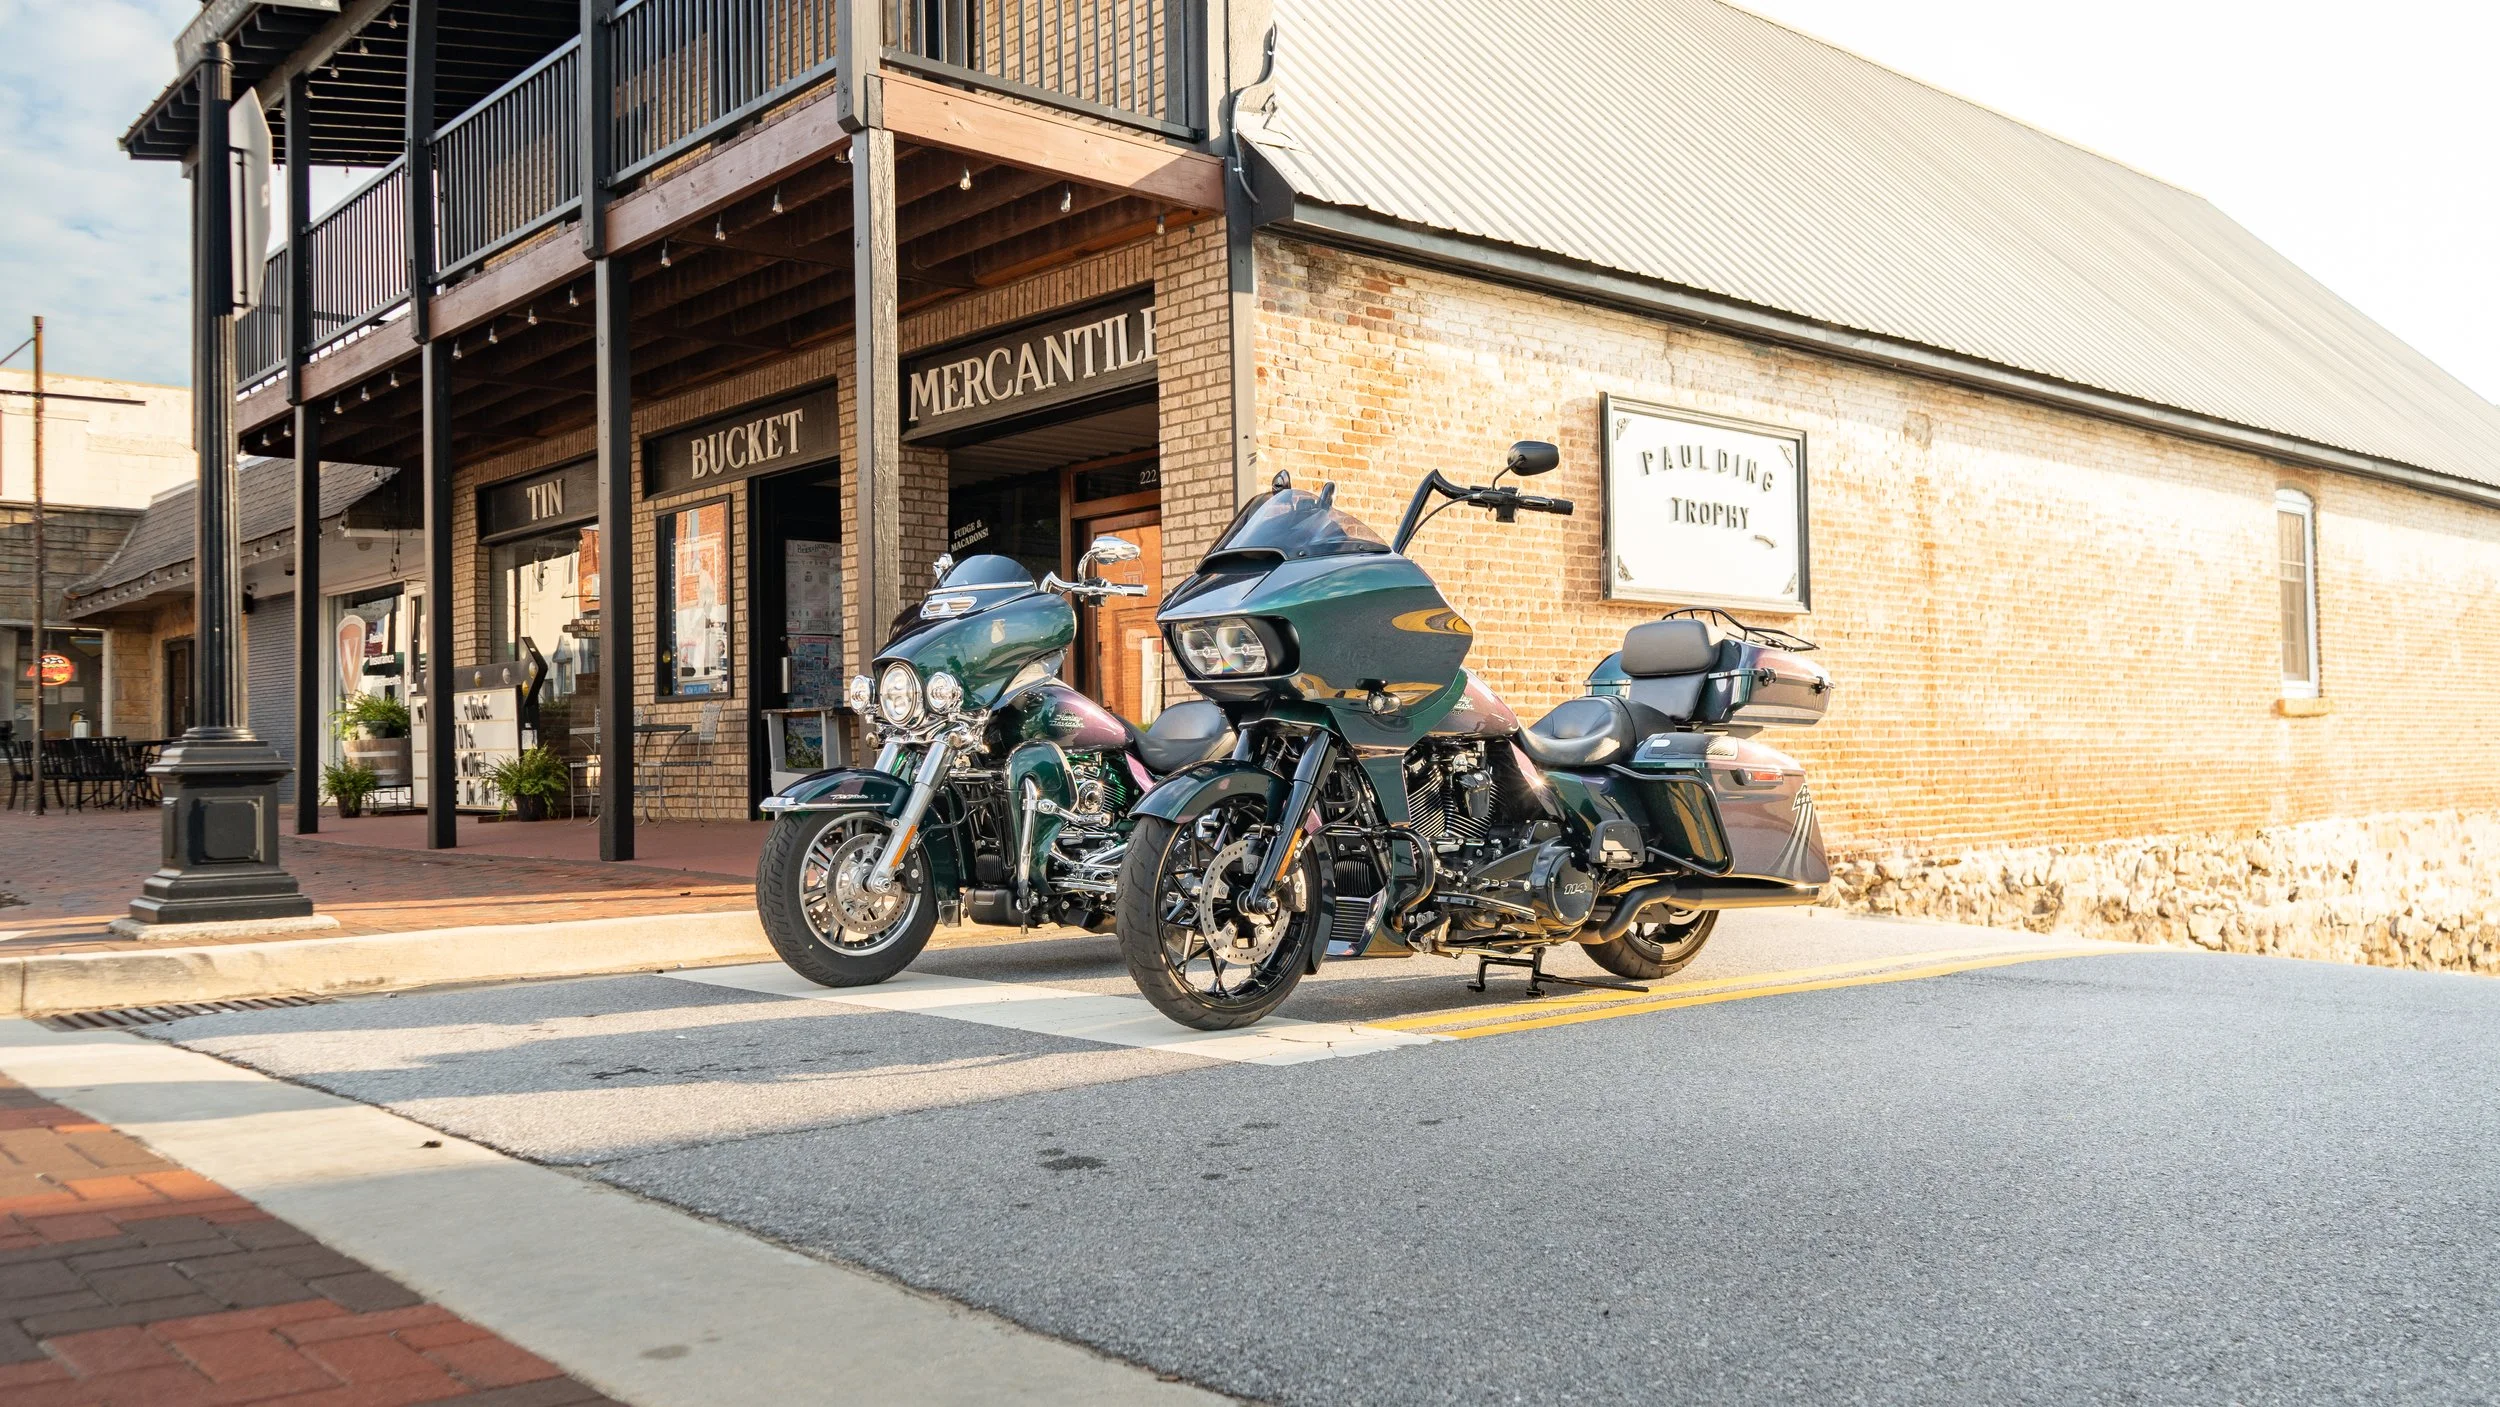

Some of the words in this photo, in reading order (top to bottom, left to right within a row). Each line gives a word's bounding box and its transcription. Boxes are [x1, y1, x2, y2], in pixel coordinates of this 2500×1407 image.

[908, 306, 1158, 422] MERCANTILE
[691, 408, 804, 480] BUCKET
[1140, 469, 1157, 485] 222
[1640, 444, 1774, 493] PAULDING
[526, 478, 565, 521] TIN
[1670, 497, 1750, 530] TROPHY
[951, 527, 989, 553] MACARONS!
[954, 522, 976, 540] FUDGE
[976, 519, 983, 529] &
[369, 654, 395, 666] Insurance
[1563, 882, 1588, 895] 114
